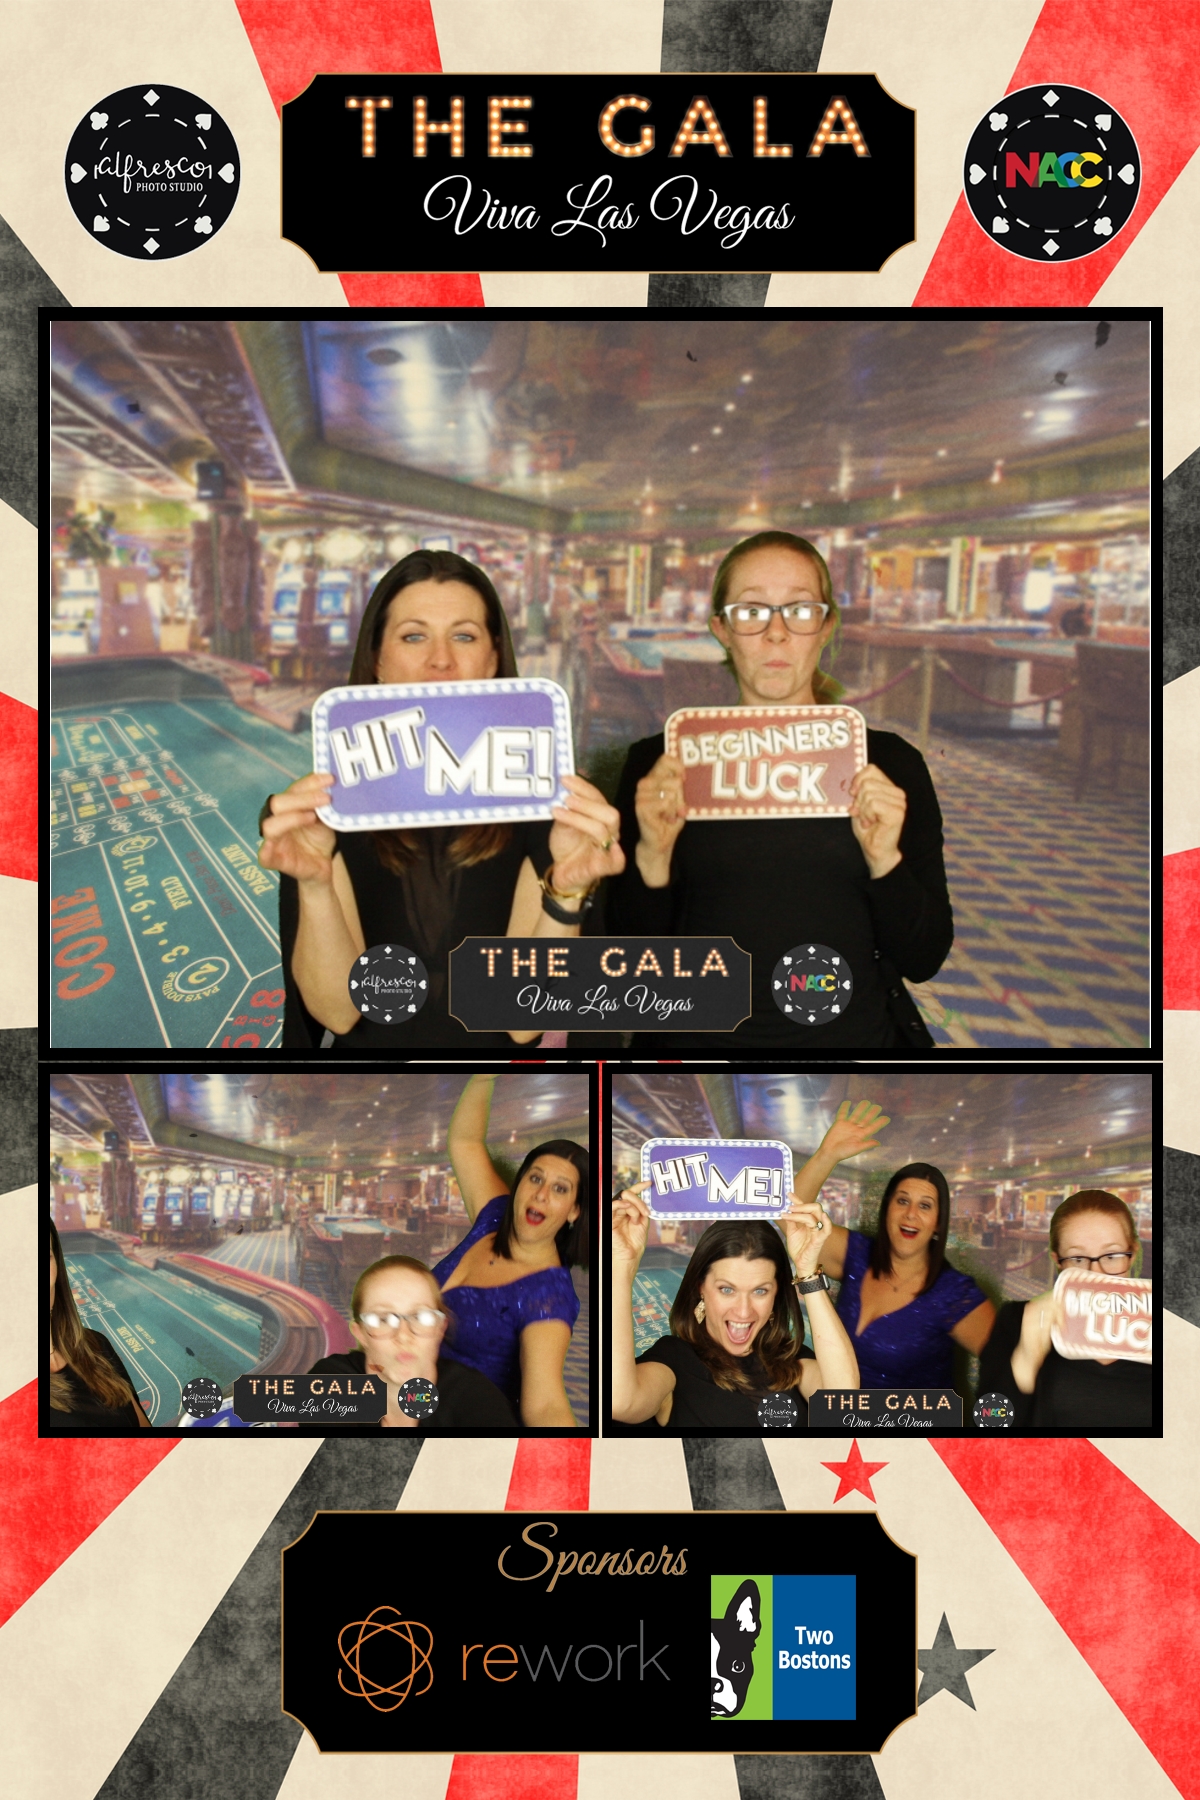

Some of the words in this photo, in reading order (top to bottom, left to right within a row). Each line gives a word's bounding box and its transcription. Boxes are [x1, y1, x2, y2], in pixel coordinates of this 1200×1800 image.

[330, 706, 425, 788] HIT
[680, 718, 850, 766] BEGINNERS
[425, 725, 554, 797] ME!
[712, 759, 827, 802] LUCK
[122, 854, 145, 870] 11
[221, 843, 252, 869] LINE
[124, 874, 149, 893] 10
[161, 876, 193, 911] FIELD
[238, 865, 275, 896] PASS
[130, 899, 157, 912] 9
[51, 886, 116, 1000] COME
[142, 921, 168, 935] 4
[161, 945, 190, 964] 3
[187, 963, 220, 984] 2
[184, 985, 221, 1002] PAYS
[250, 988, 286, 1009] 8
[652, 1152, 709, 1195] HIT
[708, 1164, 783, 1207] ME!
[1084, 1311, 1152, 1350] LUC
